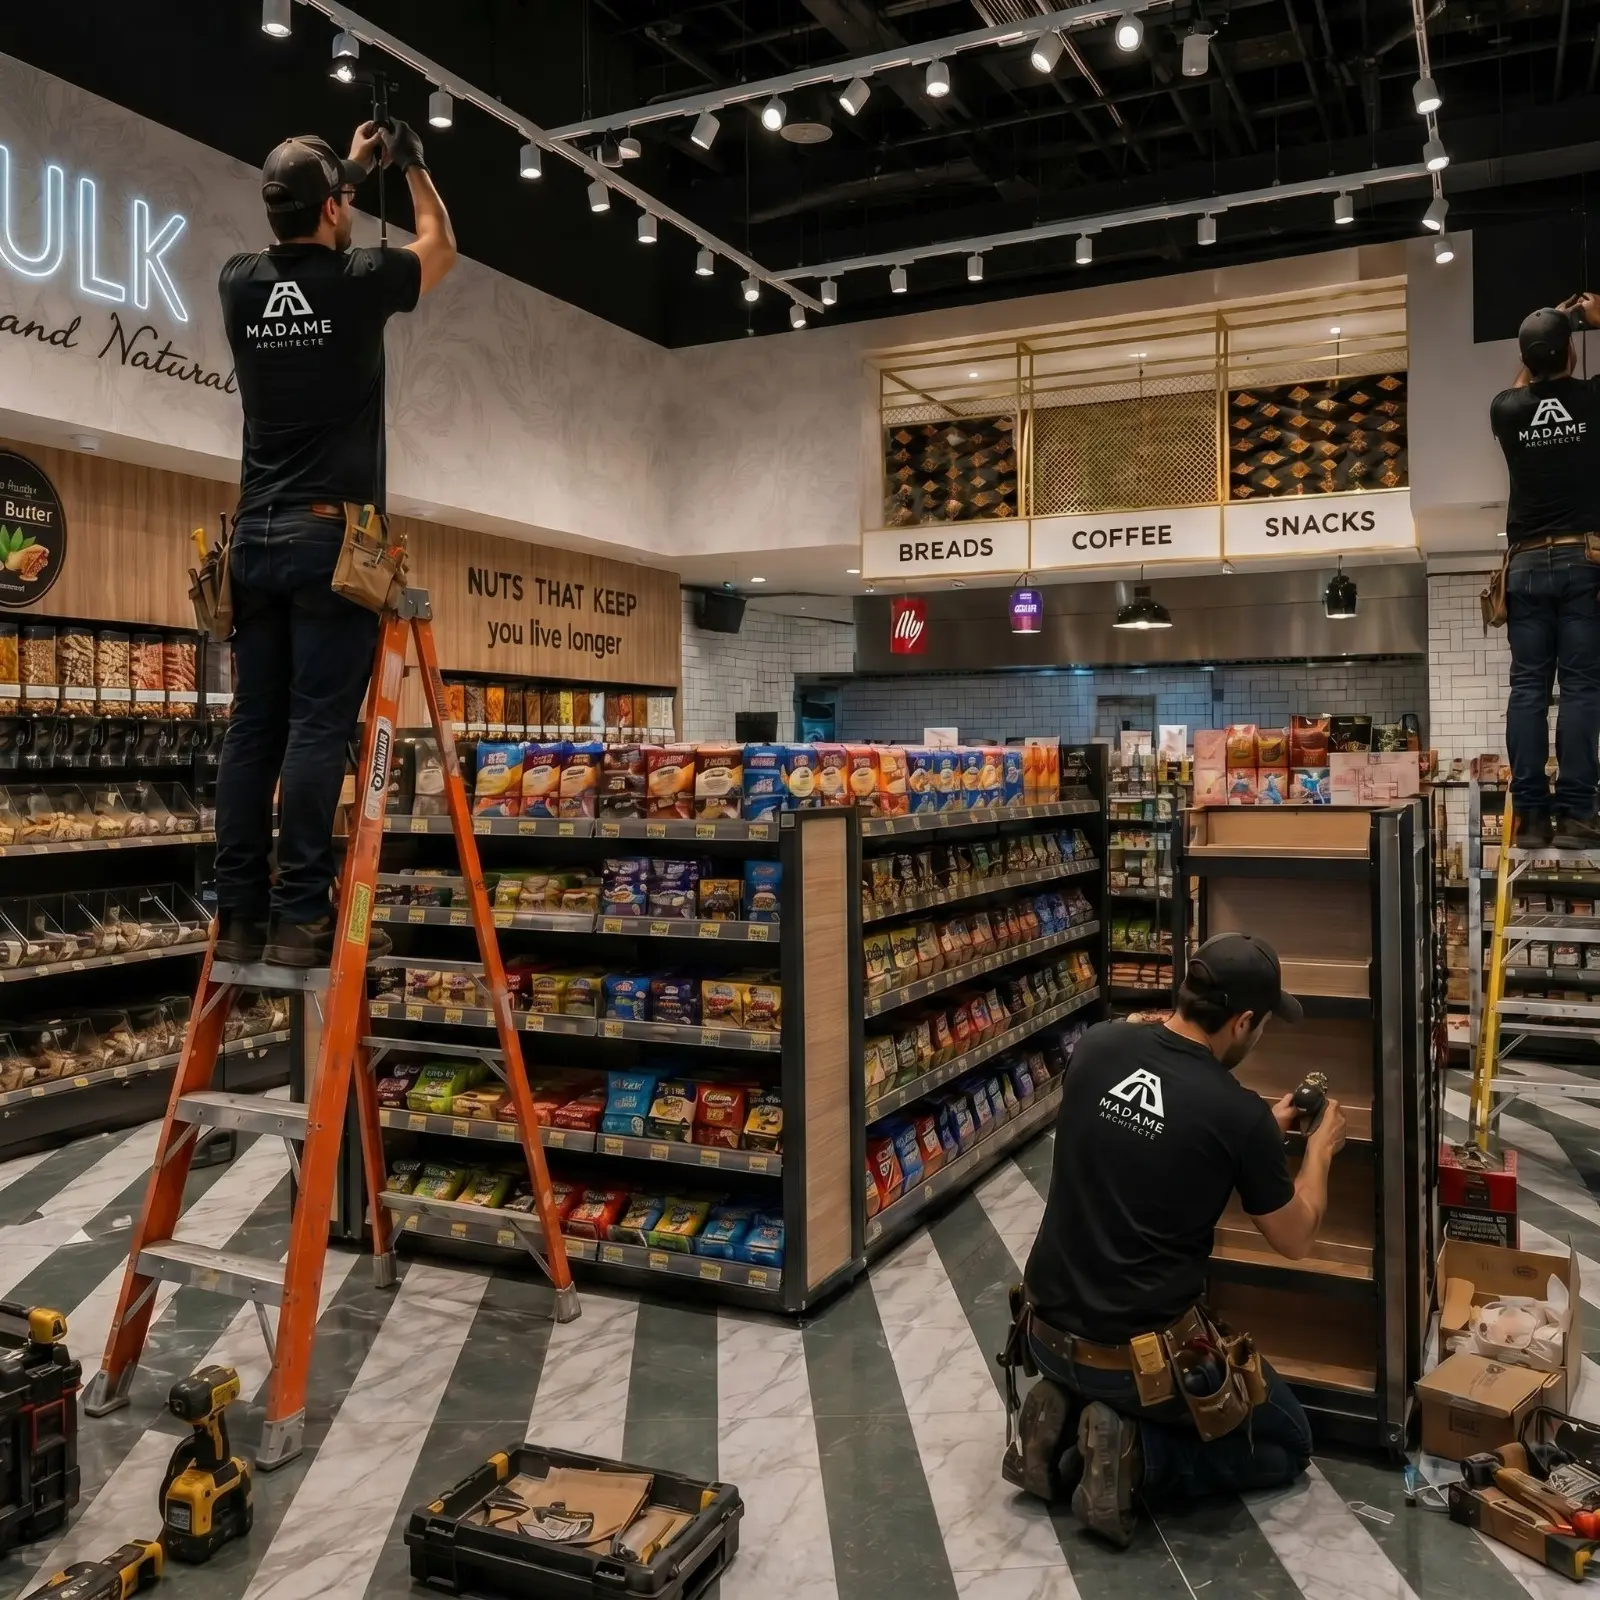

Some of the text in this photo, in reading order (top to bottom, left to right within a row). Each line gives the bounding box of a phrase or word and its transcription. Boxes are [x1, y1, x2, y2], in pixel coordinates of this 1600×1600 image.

[246, 319, 333, 338] MADAME
[98, 312, 238, 394] Natural
[256, 338, 324, 349] ARCHITECTE
[1518, 422, 1587, 441] MADAME
[5, 500, 53, 523] Butter
[1265, 510, 1376, 538] SNACKS
[899, 537, 994, 562] BREADS
[1072, 524, 1173, 551] COFFEE
[468, 566, 638, 617] NUTS THAT KEEP
[487, 618, 623, 659] you live longer
[1099, 1097, 1165, 1134] MADAME
[1099, 1111, 1155, 1141] ARCHITECTE
